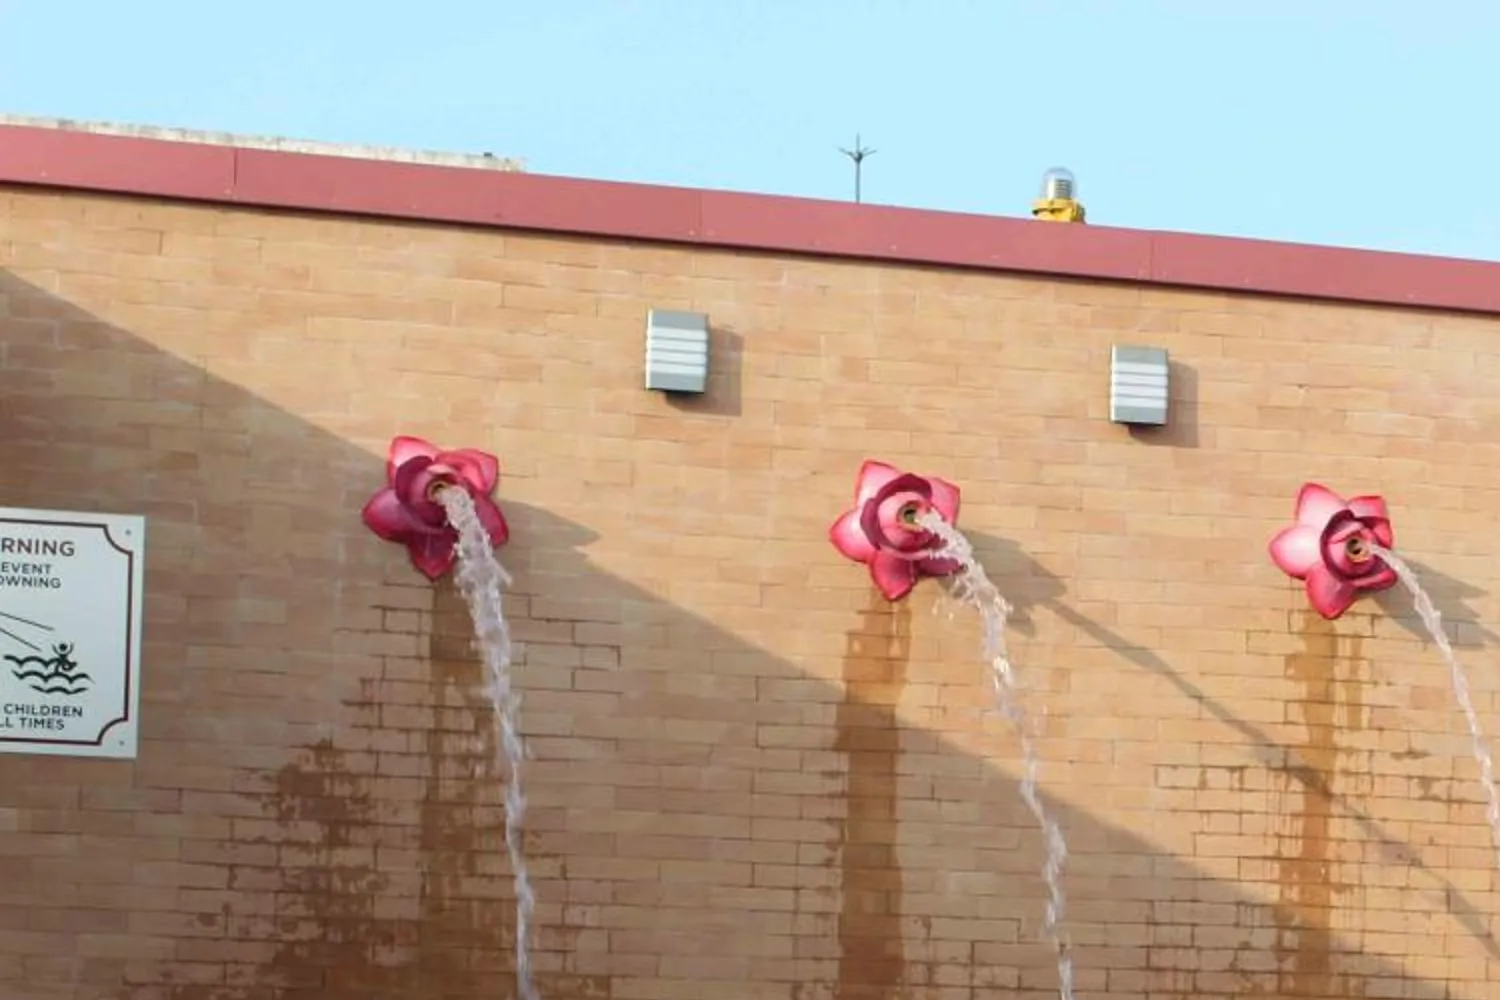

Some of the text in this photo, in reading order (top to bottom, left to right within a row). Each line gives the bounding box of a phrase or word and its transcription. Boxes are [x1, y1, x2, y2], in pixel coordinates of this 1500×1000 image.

[1, 537, 75, 557] RNING
[1, 561, 52, 574] EVENT
[3, 703, 83, 717] CHILDREN
[19, 717, 65, 730] TIMES
